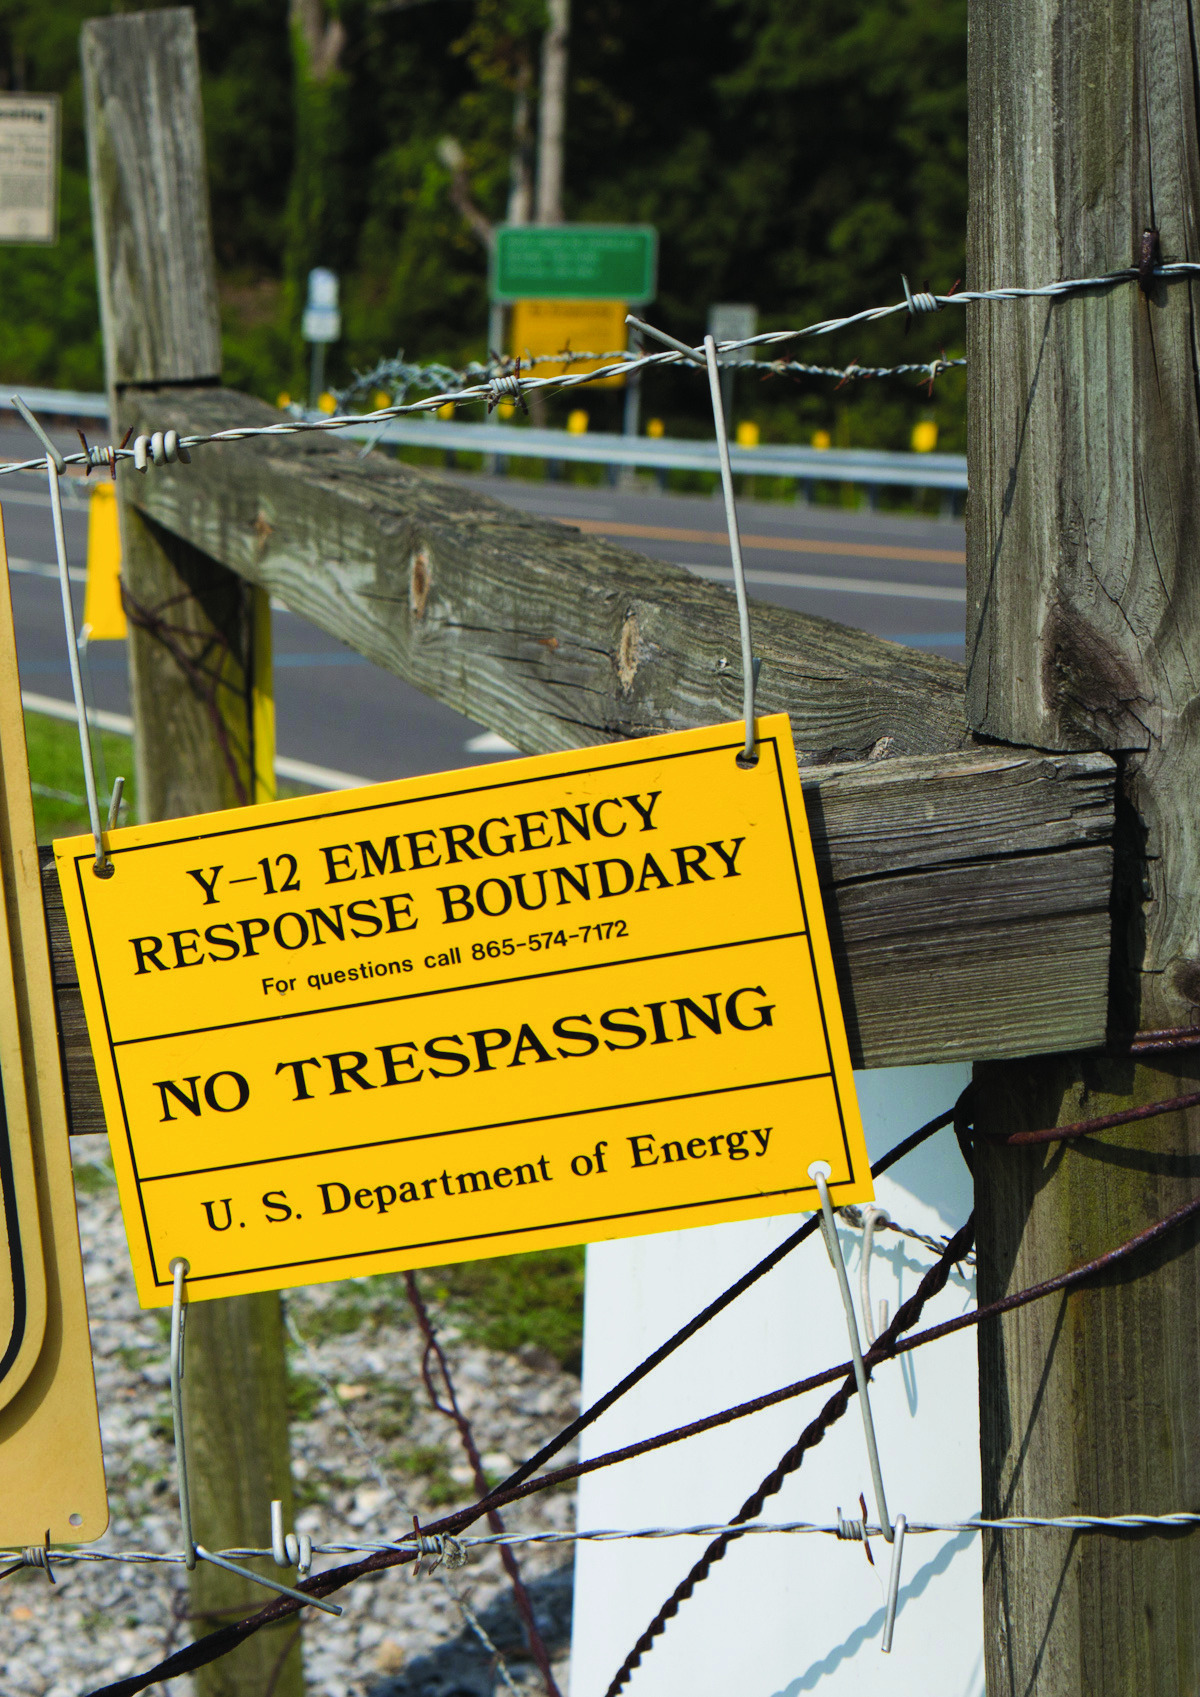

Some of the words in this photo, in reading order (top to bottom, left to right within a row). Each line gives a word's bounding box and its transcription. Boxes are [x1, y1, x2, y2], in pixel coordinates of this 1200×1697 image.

[320, 791, 661, 884] EMERGENCY
[129, 893, 418, 974] RESPONSE
[437, 837, 745, 924] BOUNDARY
[262, 977, 296, 995] For
[307, 960, 413, 989] questions
[424, 948, 462, 968] call
[472, 920, 629, 960] 865-574-7172
[153, 1071, 250, 1122] NO
[276, 986, 775, 1101] TRESPASSING
[318, 1155, 552, 1214] Department
[571, 1141, 607, 1176] of
[627, 1128, 773, 1167] Energy
